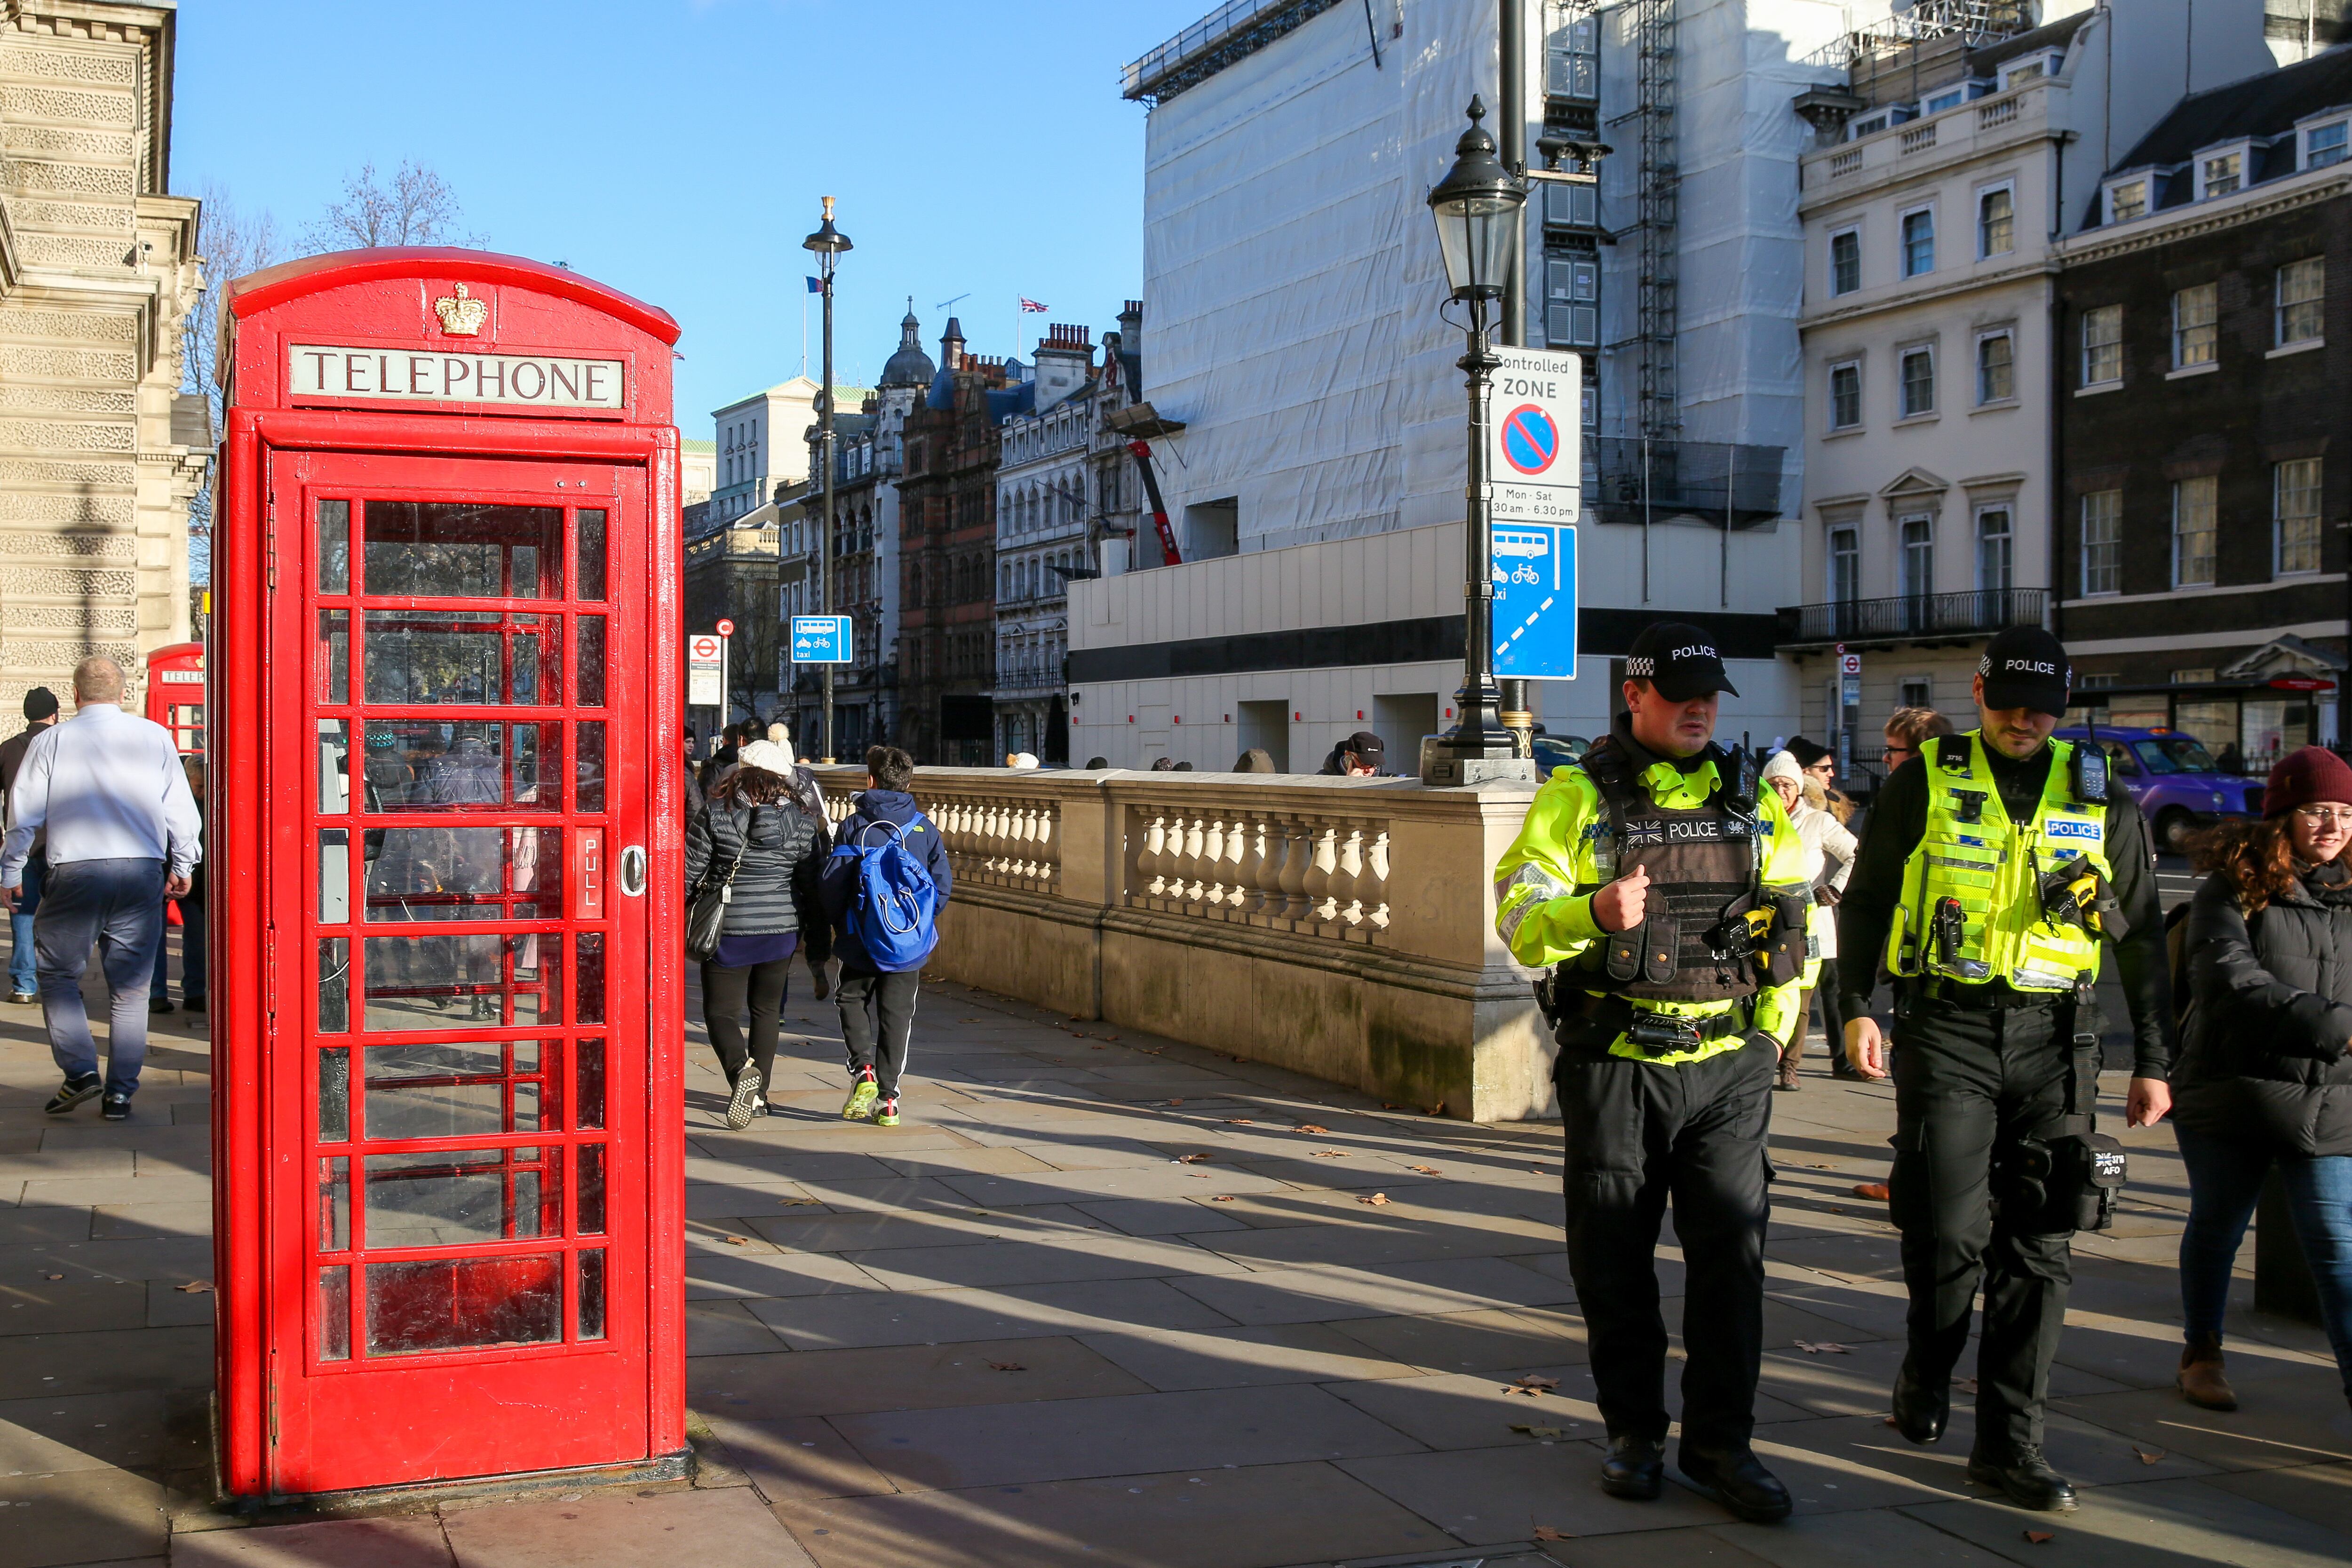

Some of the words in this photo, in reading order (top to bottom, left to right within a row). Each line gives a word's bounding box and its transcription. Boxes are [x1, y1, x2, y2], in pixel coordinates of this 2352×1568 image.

[1496, 354, 1568, 374] ontrolled
[303, 351, 608, 402] TELEPHONE
[1504, 378, 1557, 398] ZONE
[1506, 489, 1526, 499] Mon
[1536, 491, 1552, 501] Sat
[1534, 505, 1557, 515] 6.30
[1559, 509, 1573, 517] pm
[1493, 588, 1506, 600] xi
[718, 621, 730, 634] C
[1671, 645, 1717, 661] POLICE
[2005, 659, 2055, 675] POLICE
[1947, 754, 1963, 762] 3716
[1669, 821, 1718, 839] POLICE
[2051, 823, 2099, 837] POLICE
[585, 839, 596, 906] PULL
[2112, 1155, 2125, 1164] 3716
[2103, 1166, 2121, 1175] AFO
